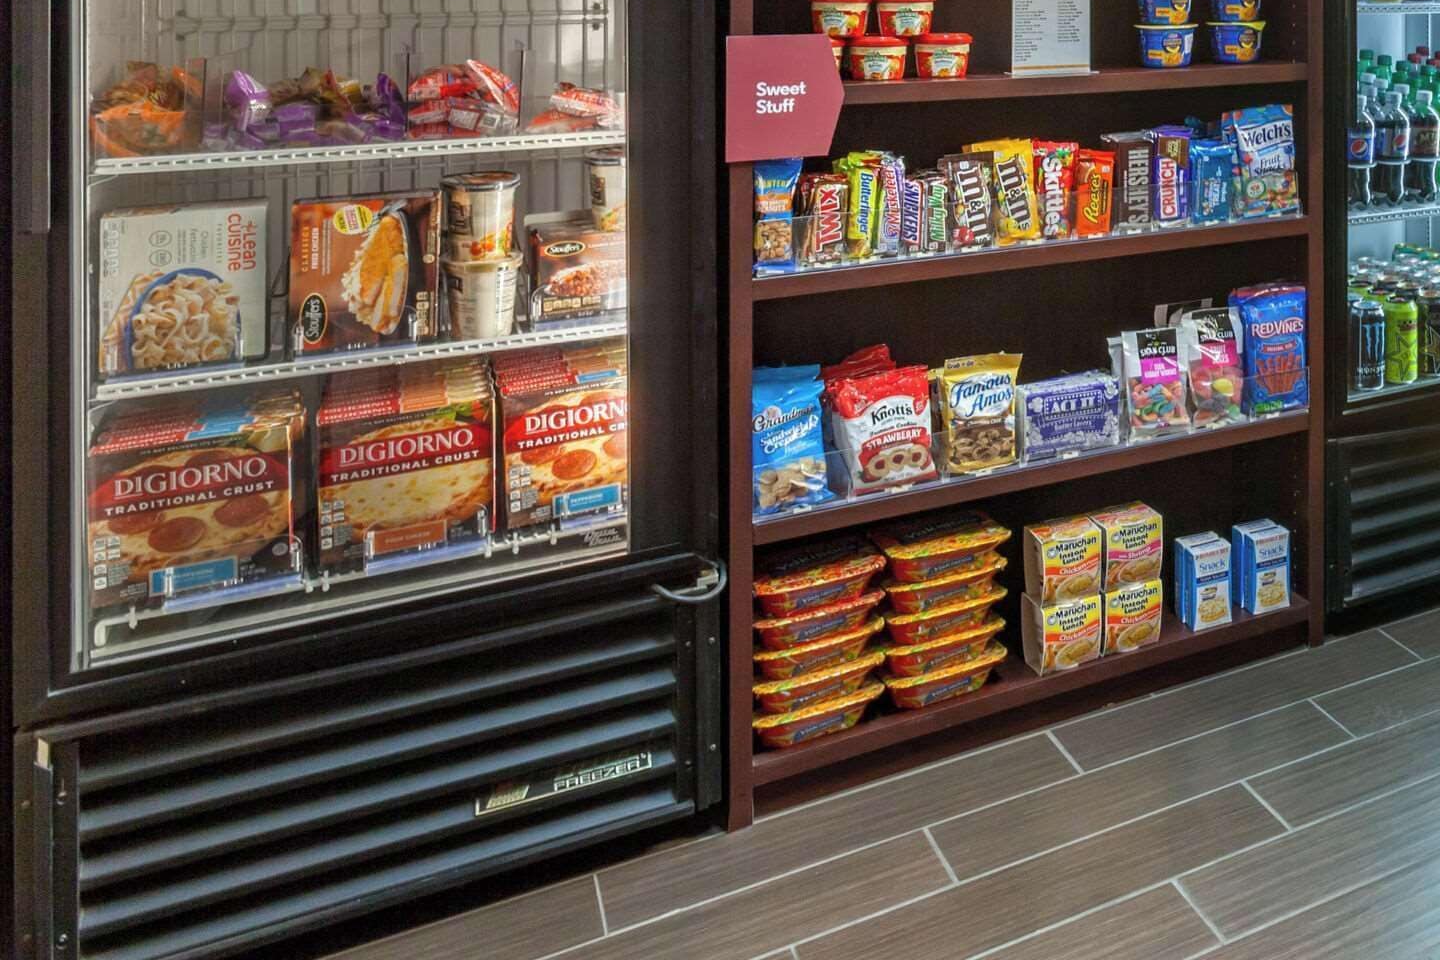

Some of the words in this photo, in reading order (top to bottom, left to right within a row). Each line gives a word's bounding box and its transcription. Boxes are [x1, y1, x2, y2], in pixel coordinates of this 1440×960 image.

[756, 81, 807, 97] Sweet
[756, 98, 795, 114] Stuff
[1243, 120, 1292, 147] Welch's
[1042, 156, 1064, 237] Skittles
[1162, 159, 1176, 218] CRUNCH
[858, 172, 874, 236] Butterfinger
[903, 182, 919, 242] SNICKERS
[305, 298, 321, 338] Stouffer's
[1158, 345, 1176, 356] CLUB
[950, 373, 1011, 409] Famous
[966, 388, 1012, 418] Amos
[525, 399, 627, 435] DIGIORN
[871, 403, 913, 426] Knott's
[339, 428, 474, 467] DIGIORNO
[518, 426, 605, 449] TRADITIONAL
[865, 429, 922, 450] STRAWBERRY
[114, 457, 268, 499] DIGIORNO
[330, 459, 429, 482] TRADITIONAL
[435, 450, 480, 463] CRUST
[104, 491, 217, 518] TRADITIONAL
[223, 479, 275, 497] CRUST
[1055, 535, 1097, 553] Maruchan
[1119, 522, 1158, 538] Maruchan
[1118, 586, 1158, 603] Maruchan
[1055, 601, 1097, 619] Maruchan
